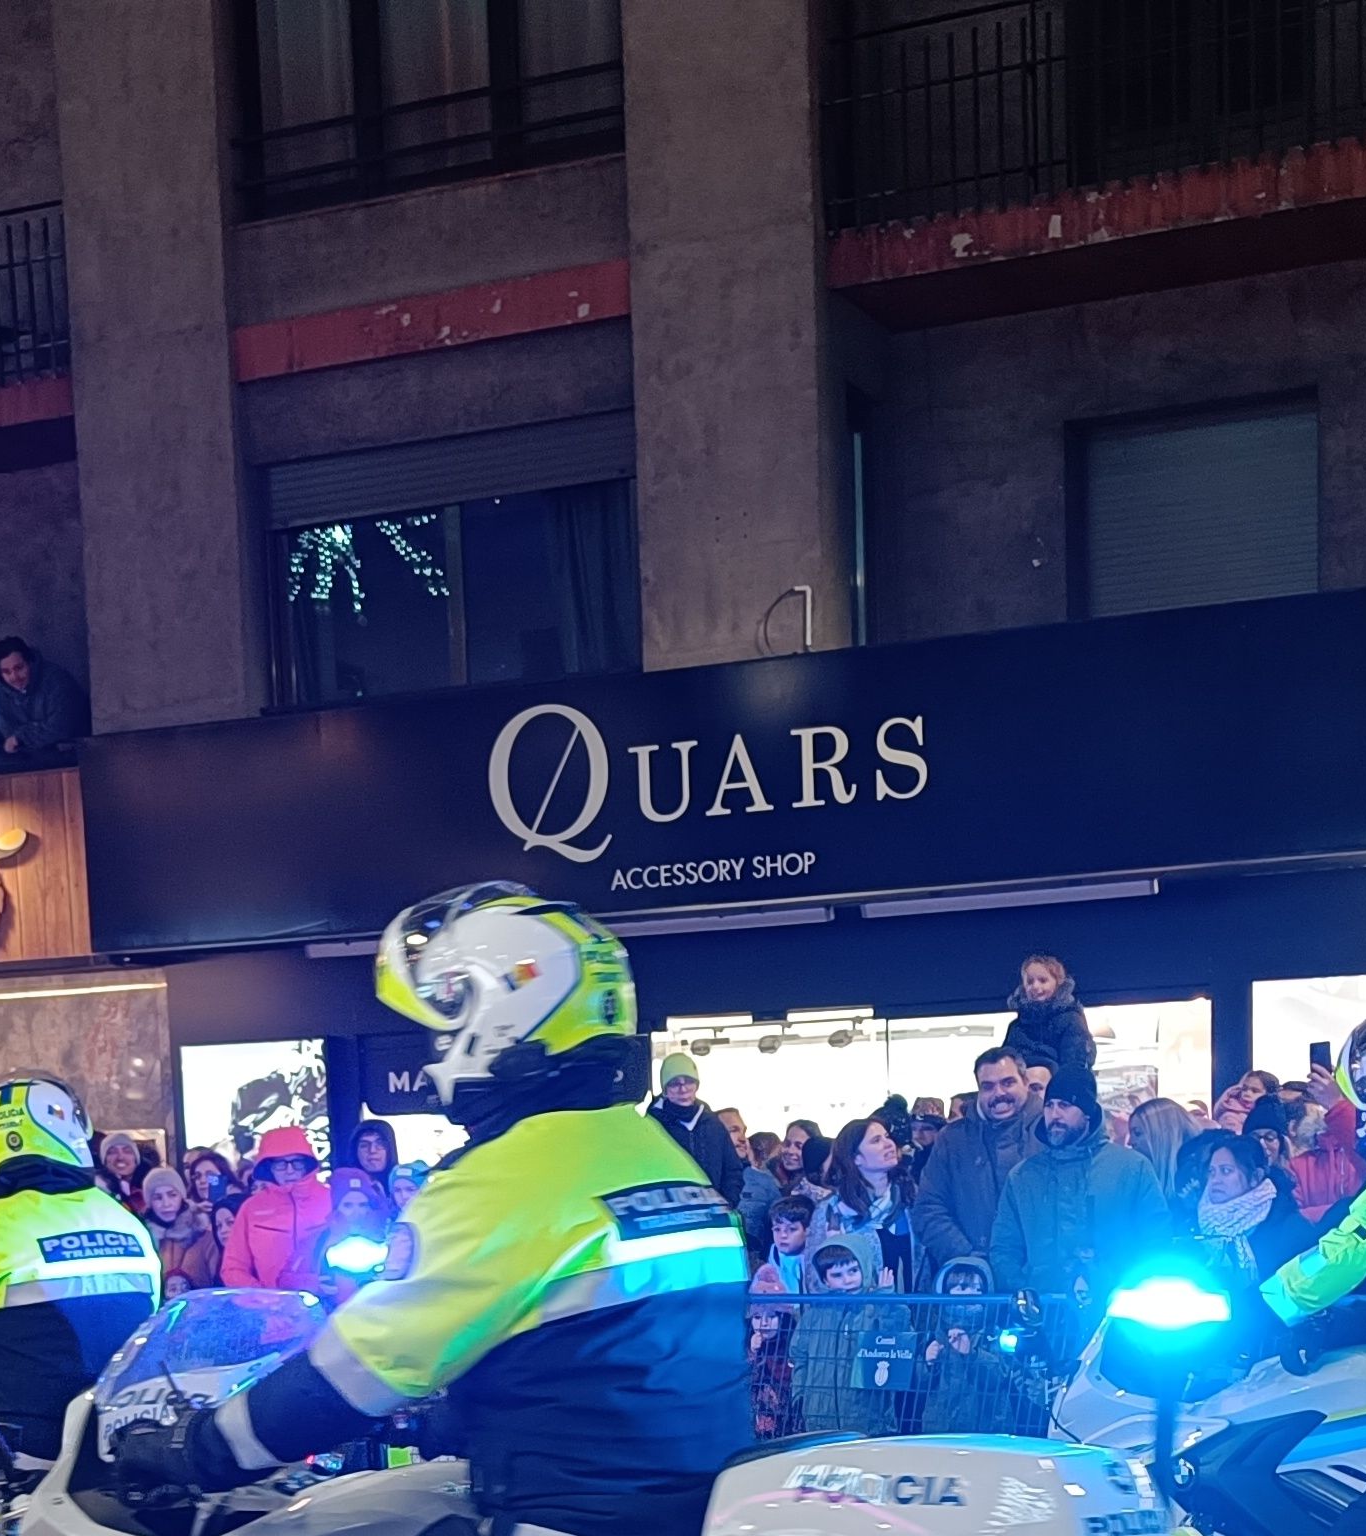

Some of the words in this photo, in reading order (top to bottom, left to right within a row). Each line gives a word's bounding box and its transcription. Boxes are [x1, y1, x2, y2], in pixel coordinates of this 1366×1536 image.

[488, 703, 928, 863] QUARS
[611, 857, 745, 892] ACCESSORY
[752, 852, 816, 879] SHOP
[42, 1233, 138, 1253] POLICIA
